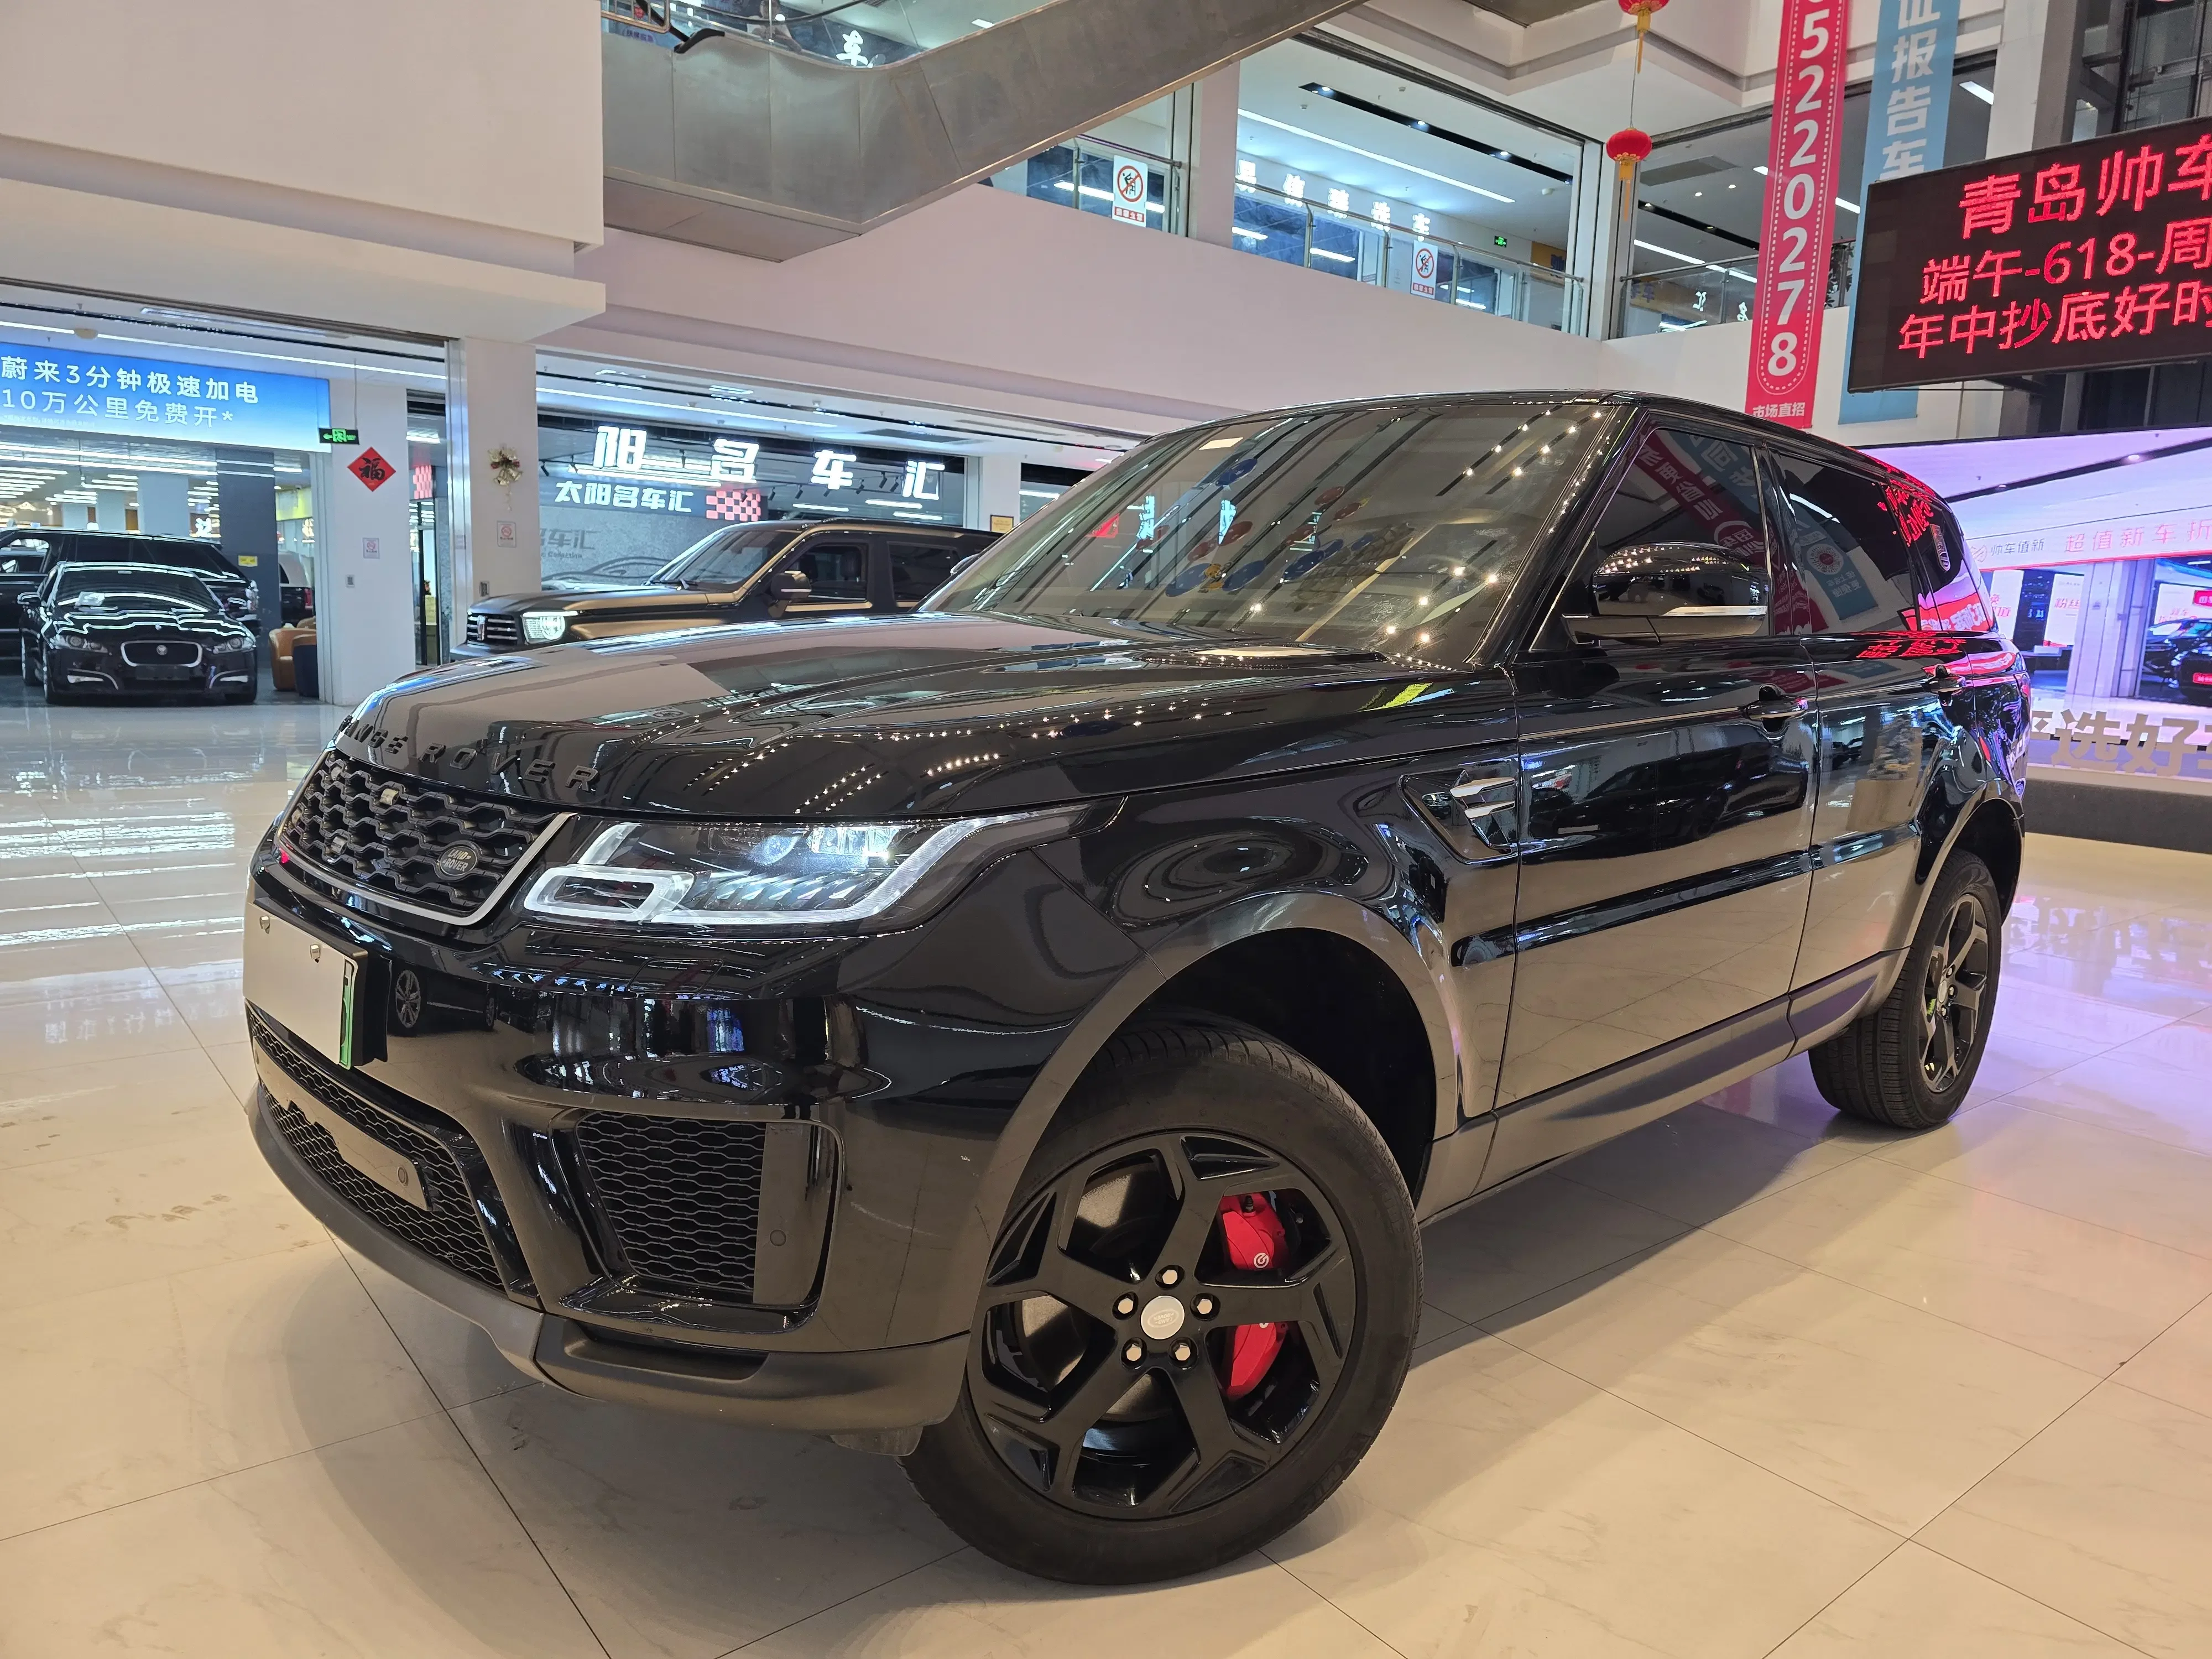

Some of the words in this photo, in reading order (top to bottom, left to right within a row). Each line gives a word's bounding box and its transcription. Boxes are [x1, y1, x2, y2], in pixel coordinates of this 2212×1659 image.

[1767, 0, 1830, 377] 5220278
[1959, 133, 2212, 239] 青岛帅车
[1, 356, 259, 404] 蔚来3分钟极速加电
[1752, 401, 1806, 418] 市场直招
[359, 457, 385, 481] 福
[555, 480, 694, 513] 太阳名车汇
[1990, 538, 2045, 556] 帅车值新
[2065, 519, 2212, 552] 超值新车折
[419, 743, 599, 792] ROVER
[444, 858, 468, 872] ROVER
[447, 848, 468, 860] LAND
